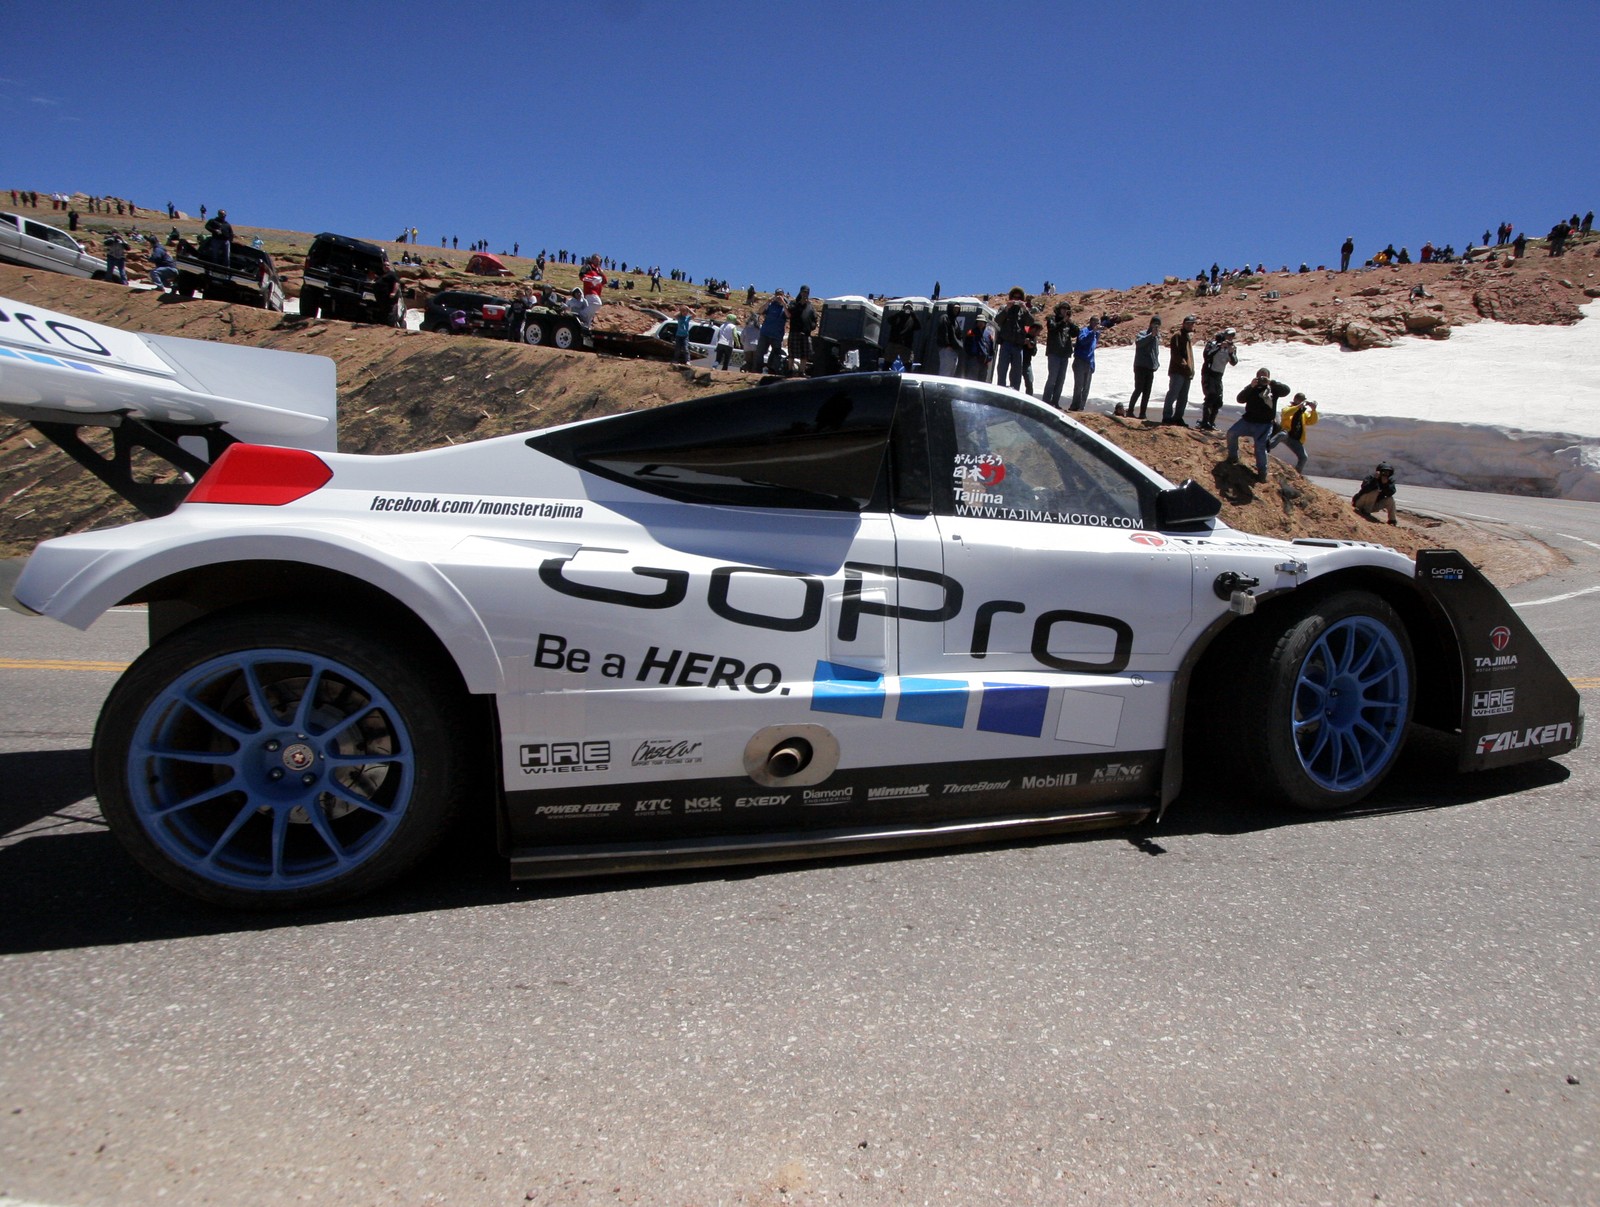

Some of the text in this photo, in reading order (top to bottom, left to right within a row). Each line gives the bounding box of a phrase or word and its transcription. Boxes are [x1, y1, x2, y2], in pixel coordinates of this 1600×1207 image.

[954, 454, 1003, 466] がんばろう
[953, 465, 985, 482] 日本
[953, 487, 1003, 504] Tajima
[369, 495, 584, 519] facebook.com/monstertajima
[955, 504, 1144, 530] WWW.TAJIMA-MOTOR.COM
[1431, 567, 1464, 575] GoPro
[538, 546, 1134, 675] GoPro
[533, 633, 791, 696] Be a HERO.
[1474, 654, 1518, 667] TAJIMA
[1473, 688, 1514, 709] HRE
[1473, 706, 1513, 715] WHEELS
[1475, 722, 1573, 755] FALKEN
[519, 740, 611, 768] HRE
[523, 764, 609, 775] WHEELS
[942, 780, 1011, 794] ThreeBond
[534, 802, 621, 815] POWER FILTER
[634, 798, 673, 812] KTC
[684, 796, 722, 809] NGK
[735, 795, 791, 808] EXEDY
